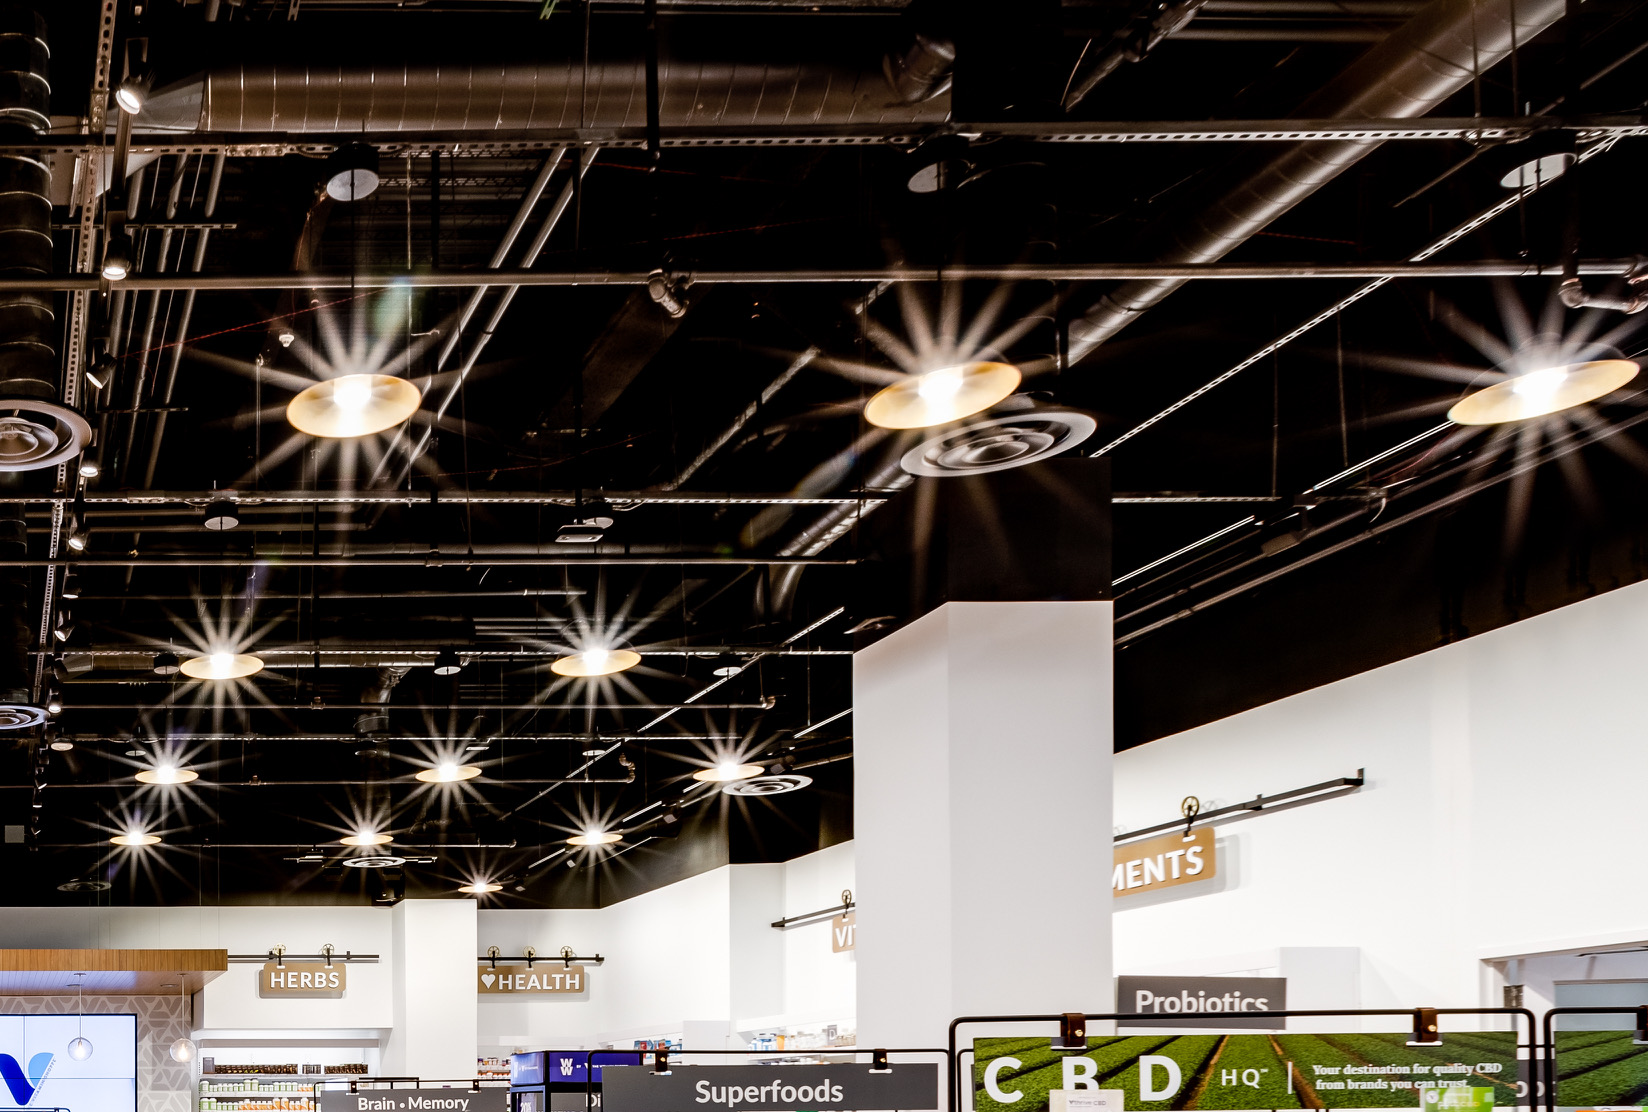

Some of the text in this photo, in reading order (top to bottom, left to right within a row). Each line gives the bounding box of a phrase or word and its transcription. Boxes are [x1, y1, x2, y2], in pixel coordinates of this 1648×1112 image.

[271, 971, 340, 989] HERBS
[499, 973, 580, 990] HEALTH
[1136, 990, 1268, 1013] Probiotics
[1313, 1062, 1502, 1076] Your destination for quality CBD
[695, 1079, 844, 1107] Superfoods
[1316, 1078, 1470, 1092] from brands you can trust.
[358, 1096, 469, 1111] Brain Memory
